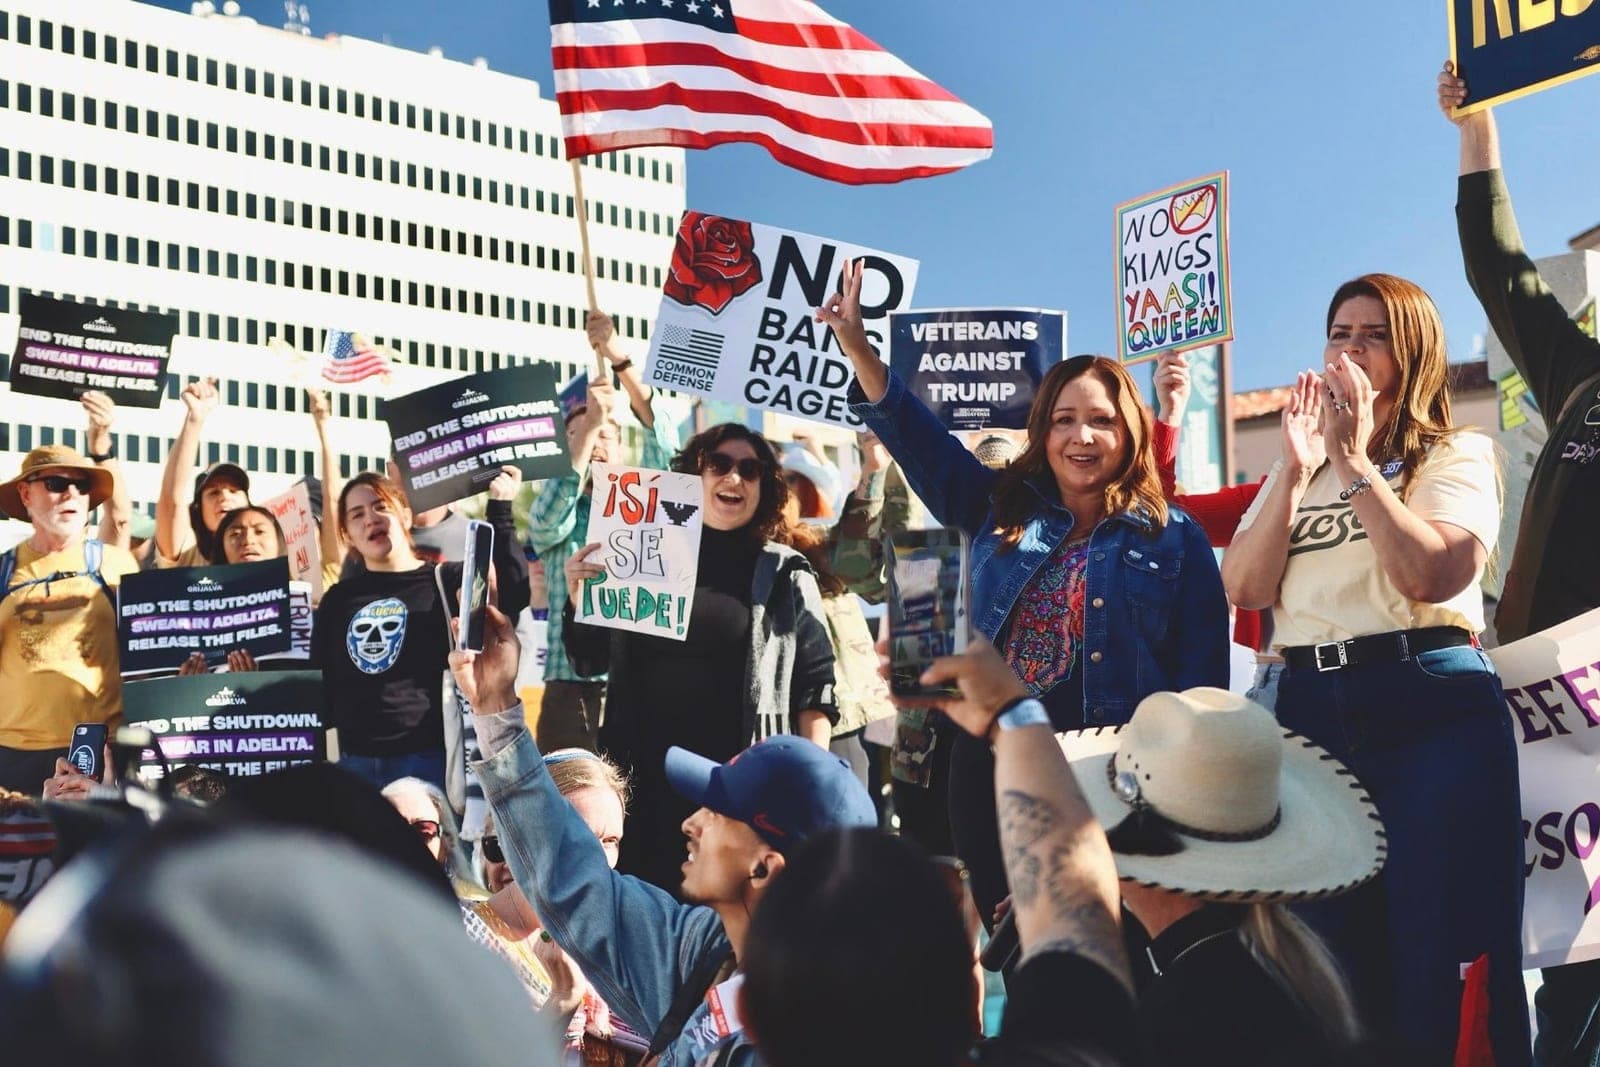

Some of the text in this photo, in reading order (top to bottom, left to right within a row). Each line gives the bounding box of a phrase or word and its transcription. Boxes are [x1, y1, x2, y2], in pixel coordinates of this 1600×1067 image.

[1124, 208, 1170, 246] NO
[1124, 233, 1213, 287] KINGS
[767, 234, 904, 319] NO
[1125, 271, 1215, 323] YAAS!!
[20, 327, 170, 358] END THE SHUTDOWN.
[911, 321, 1039, 342] VETERANS
[1127, 305, 1219, 352] QUEEN
[25, 346, 160, 375] SWEAR IN ADELITA.
[655, 358, 717, 382] COMMON
[749, 343, 858, 389] RAID
[918, 351, 1026, 372] AGAINST
[19, 364, 86, 384] RELEASE
[86, 373, 118, 388] THE
[117, 376, 159, 392] FILES.
[653, 370, 714, 392] DEFENSE
[927, 383, 1016, 403] TRUMP
[394, 400, 560, 451] END THE SHUTDOWN.
[408, 421, 556, 469] SWEAR IN ADELITA.
[411, 456, 479, 490] RELEASE
[479, 447, 515, 466] THE
[514, 441, 563, 459] FILES.
[605, 528, 665, 580] SE
[122, 588, 287, 617] END THE SHUTDOWN.
[187, 583, 223, 593] GRIJALVA
[582, 570, 686, 636] PUEDE!
[131, 607, 280, 633] SWEAR IN ADELITA.
[128, 623, 283, 651] RELEASE THE FILES.
[171, 716, 210, 733] THE
[213, 713, 322, 731] SHUTDOWN.
[213, 739, 234, 753] IN
[236, 736, 314, 753] ADELITA.
[225, 761, 262, 776] THE
